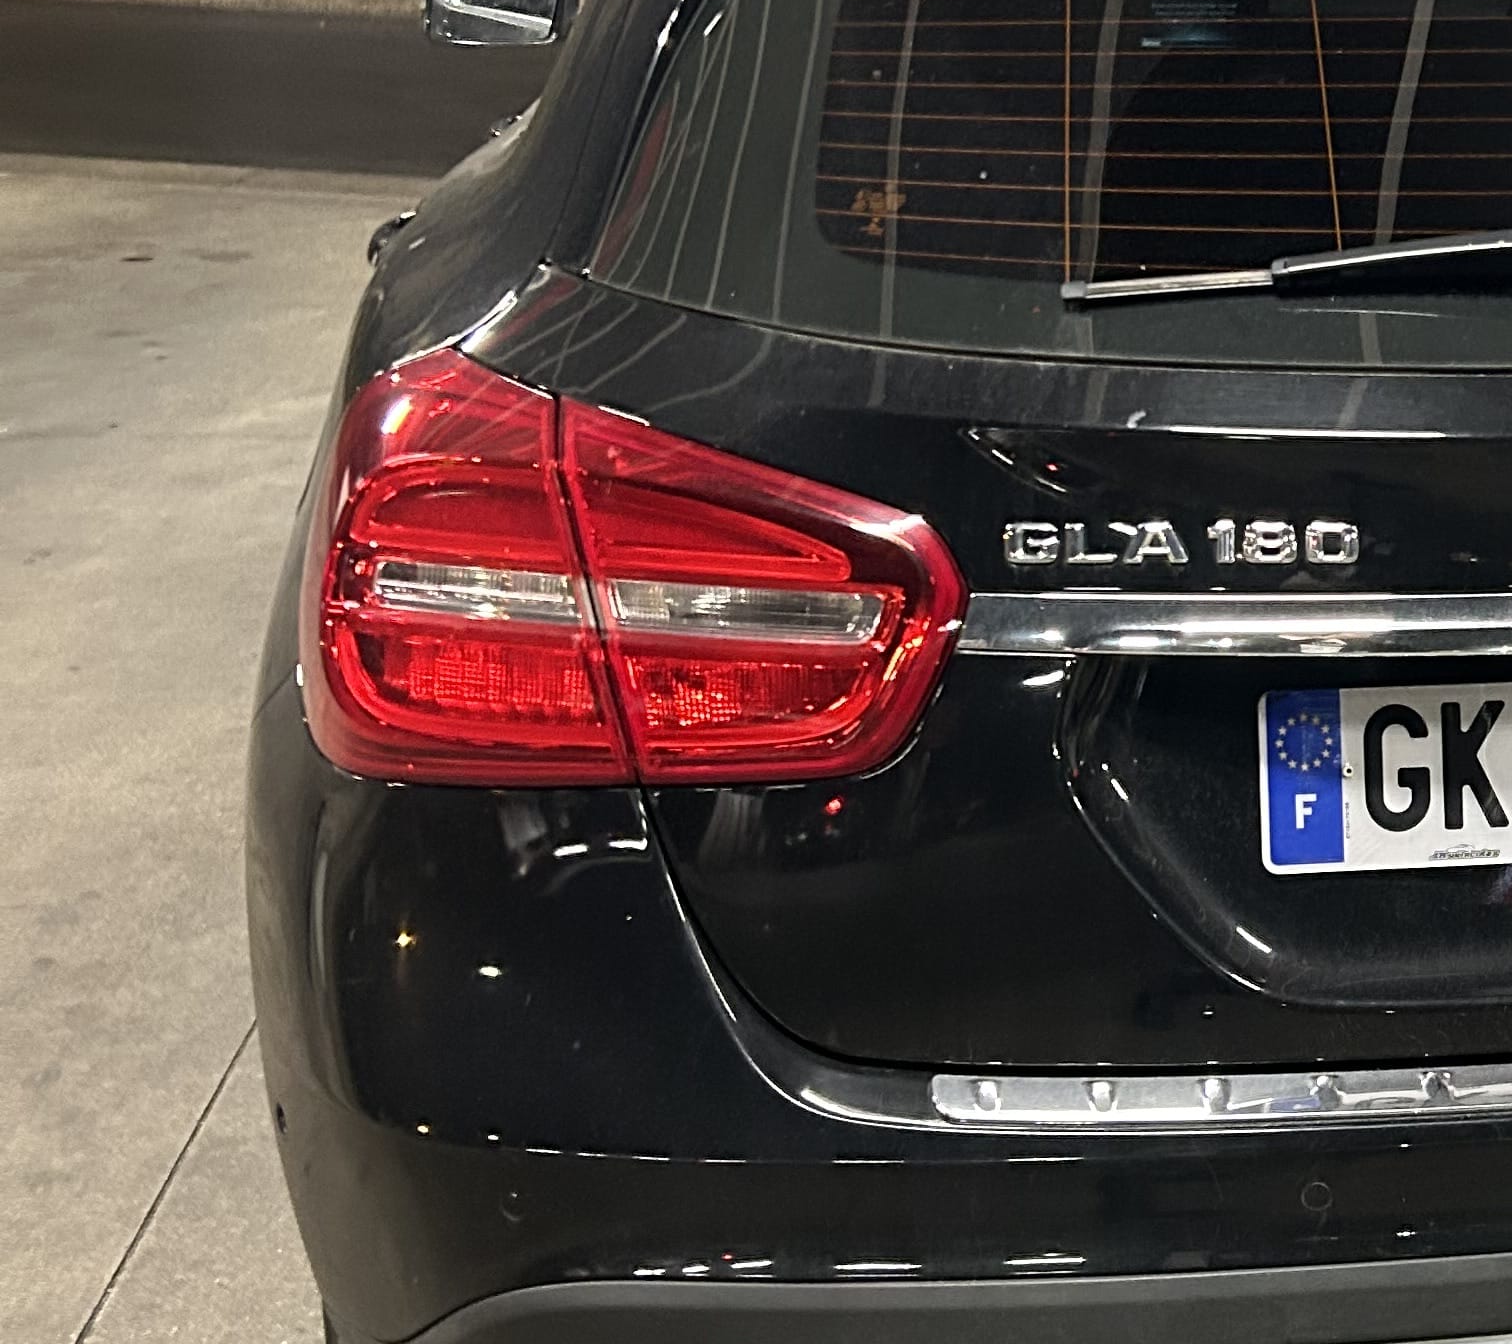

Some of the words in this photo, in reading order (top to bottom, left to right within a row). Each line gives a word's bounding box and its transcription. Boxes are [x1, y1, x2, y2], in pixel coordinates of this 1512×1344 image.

[1003, 520, 1189, 565] GLA
[1207, 519, 1360, 565] 180
[1295, 793, 1317, 829] F
